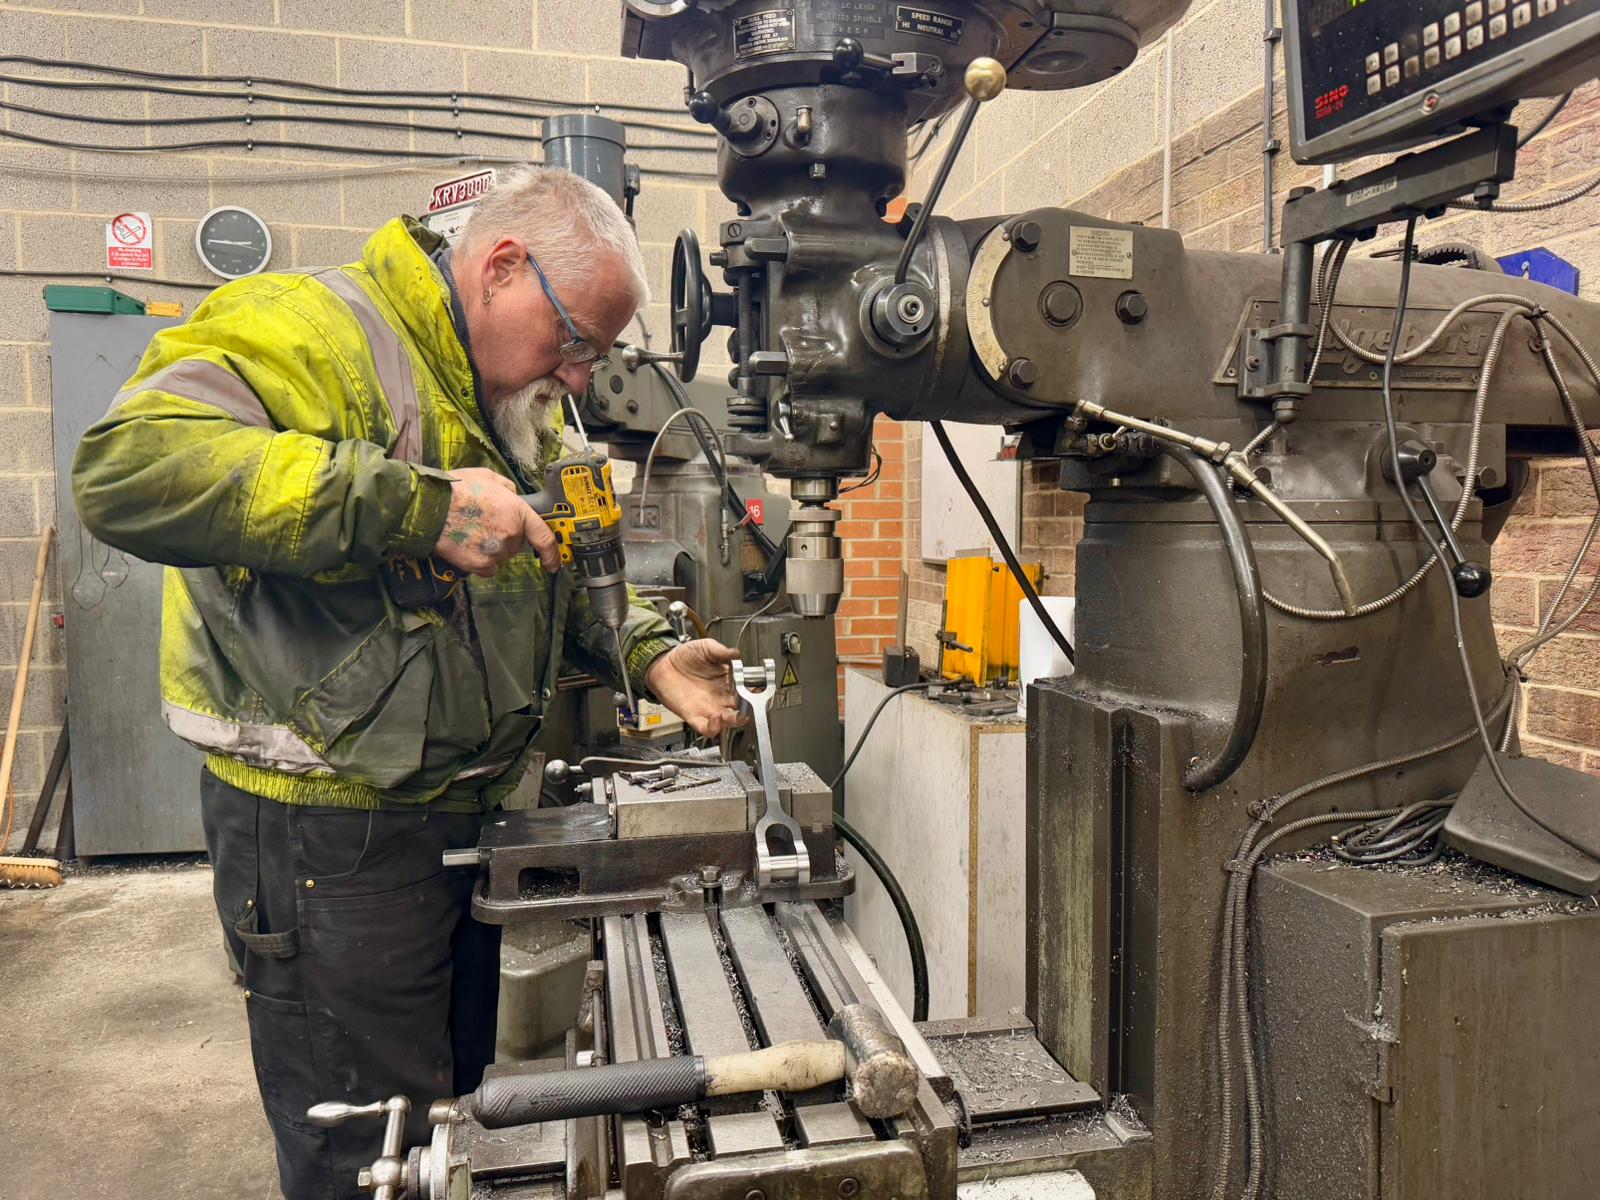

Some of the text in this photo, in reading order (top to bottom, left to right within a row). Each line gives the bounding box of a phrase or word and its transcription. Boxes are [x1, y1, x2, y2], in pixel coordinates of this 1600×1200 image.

[911, 12, 953, 27] SPEED RANGE
[901, 21, 911, 29] HI
[917, 23, 944, 36] NEUTRAL
[1314, 84, 1349, 110] SINO
[749, 505, 760, 518] 16
